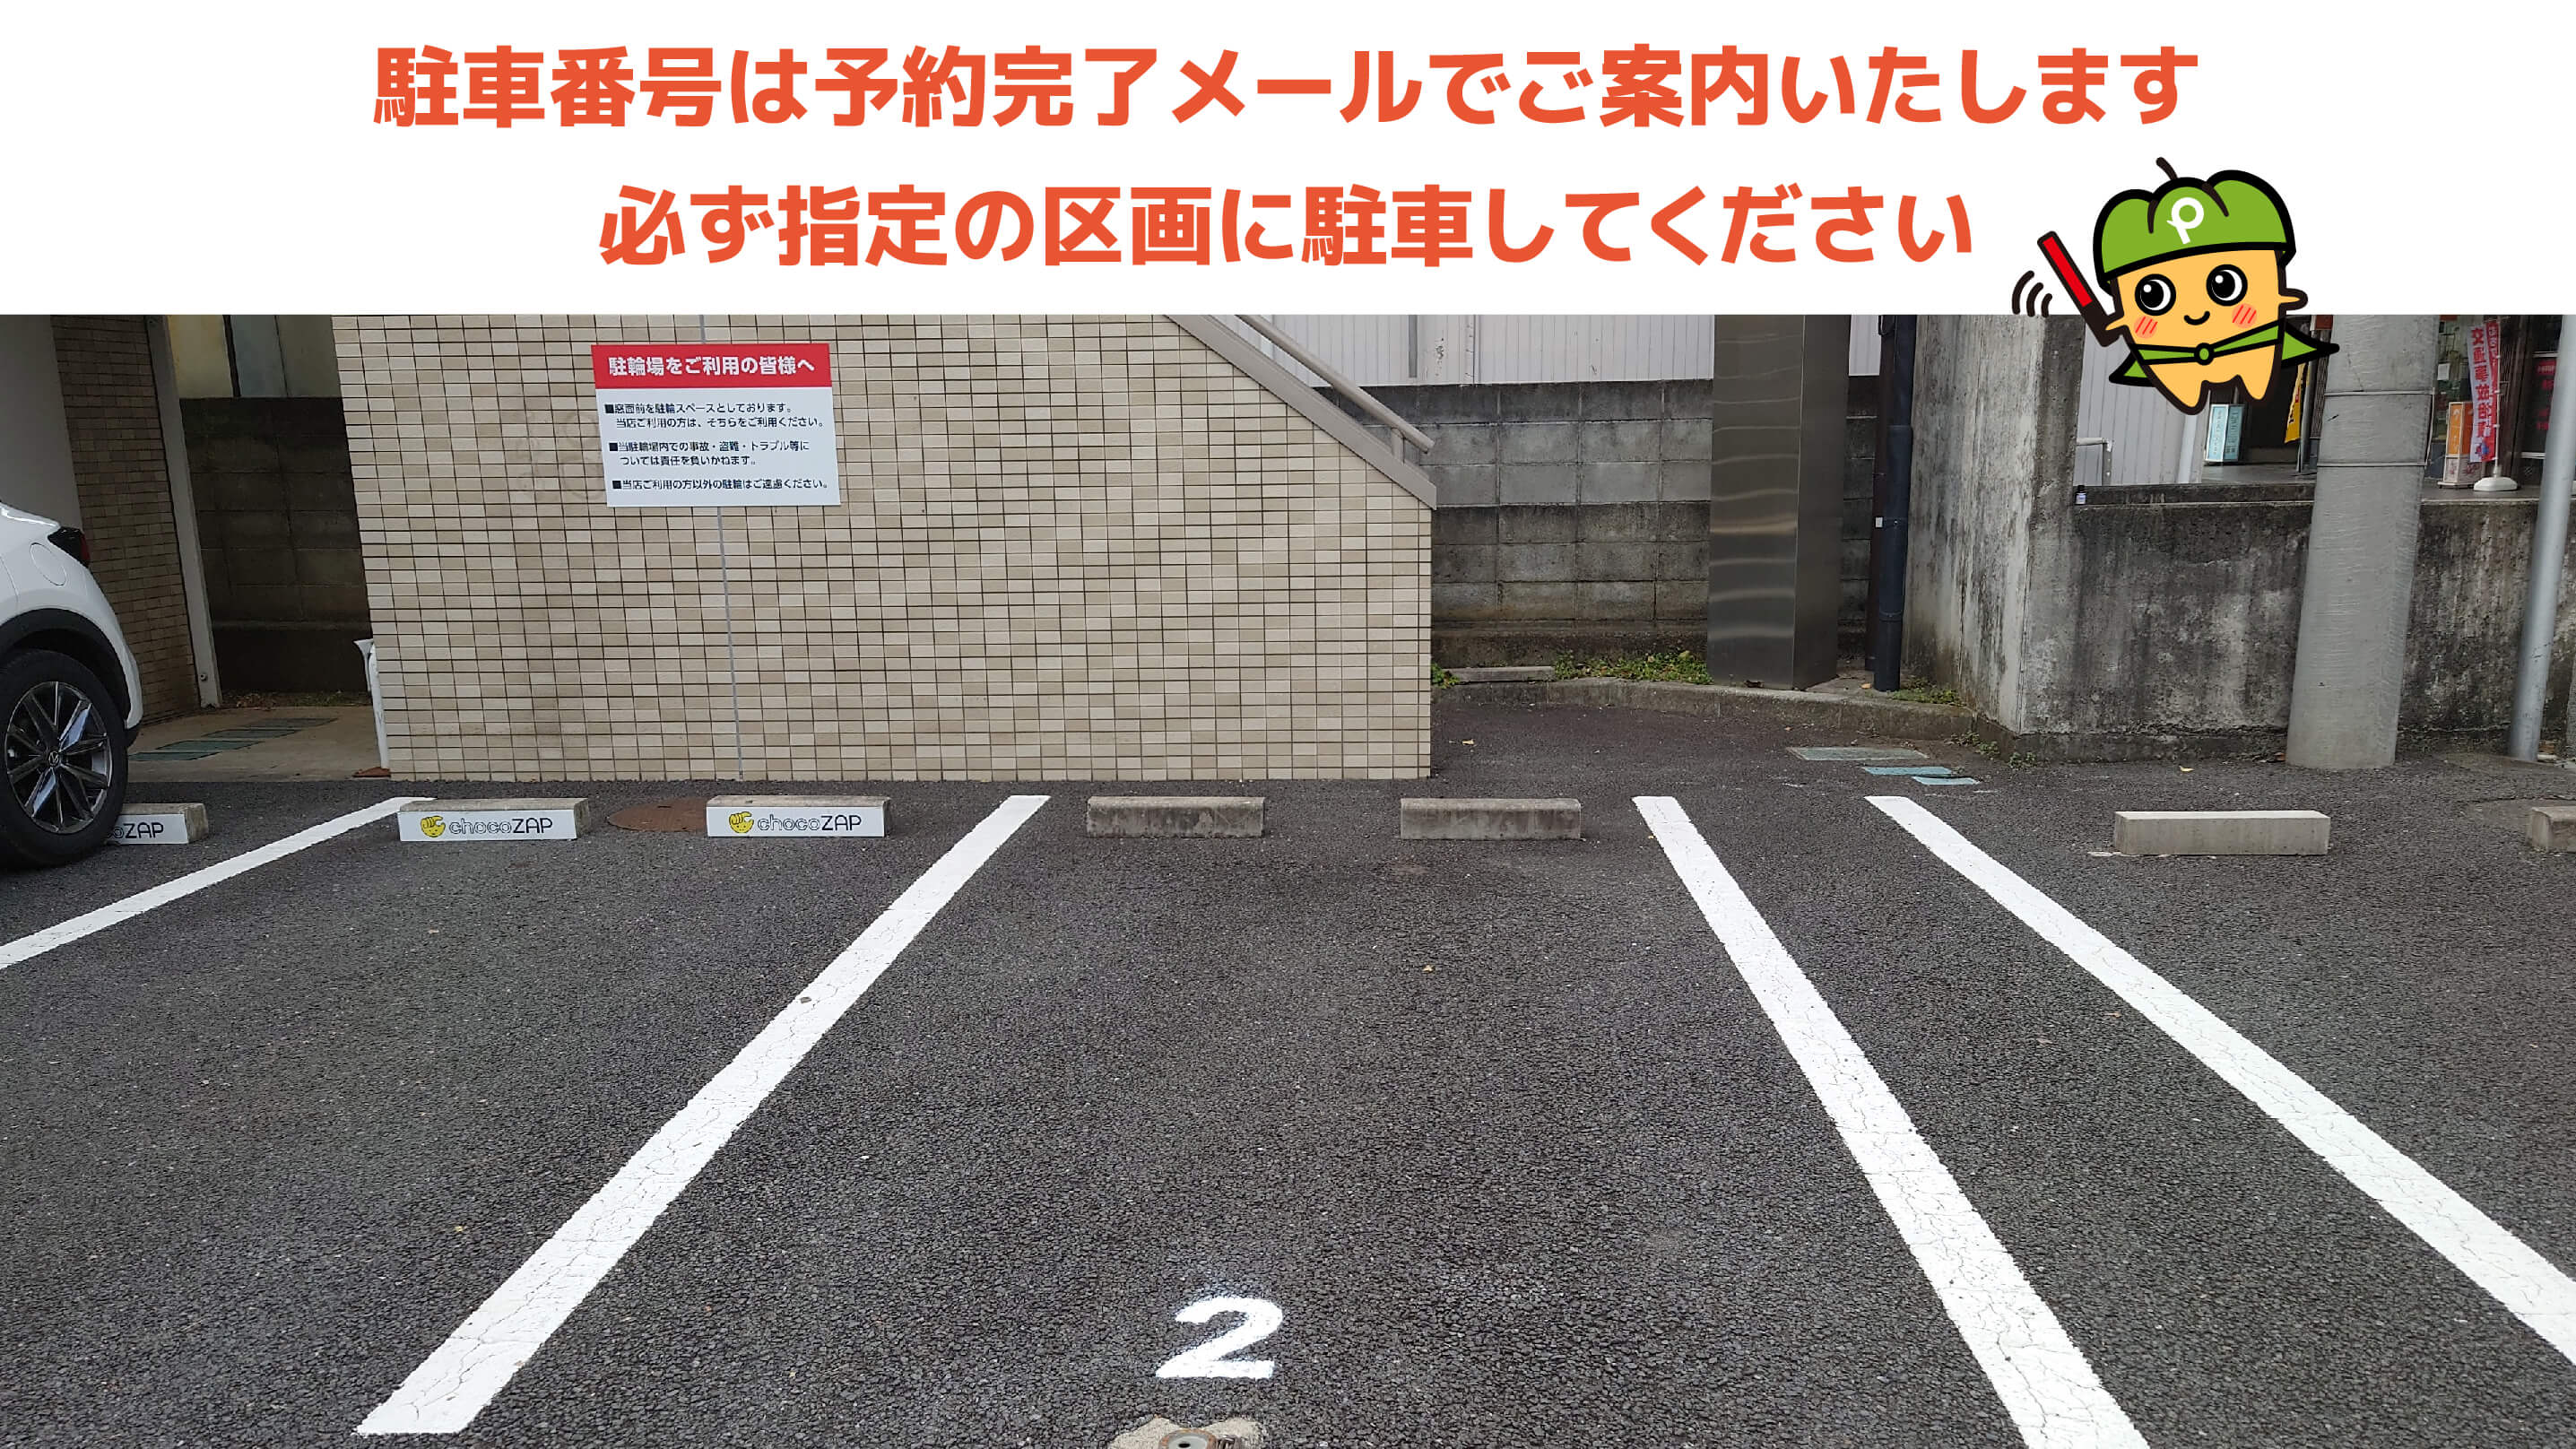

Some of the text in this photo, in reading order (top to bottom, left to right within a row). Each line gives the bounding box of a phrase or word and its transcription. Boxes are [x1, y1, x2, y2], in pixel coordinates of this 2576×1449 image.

[609, 356, 815, 377] 駐輪場をご利用の皆様へ
[448, 817, 553, 835] chocoZAP
[756, 813, 863, 832] chocoZAP
[1155, 1297, 1283, 1379] 2
